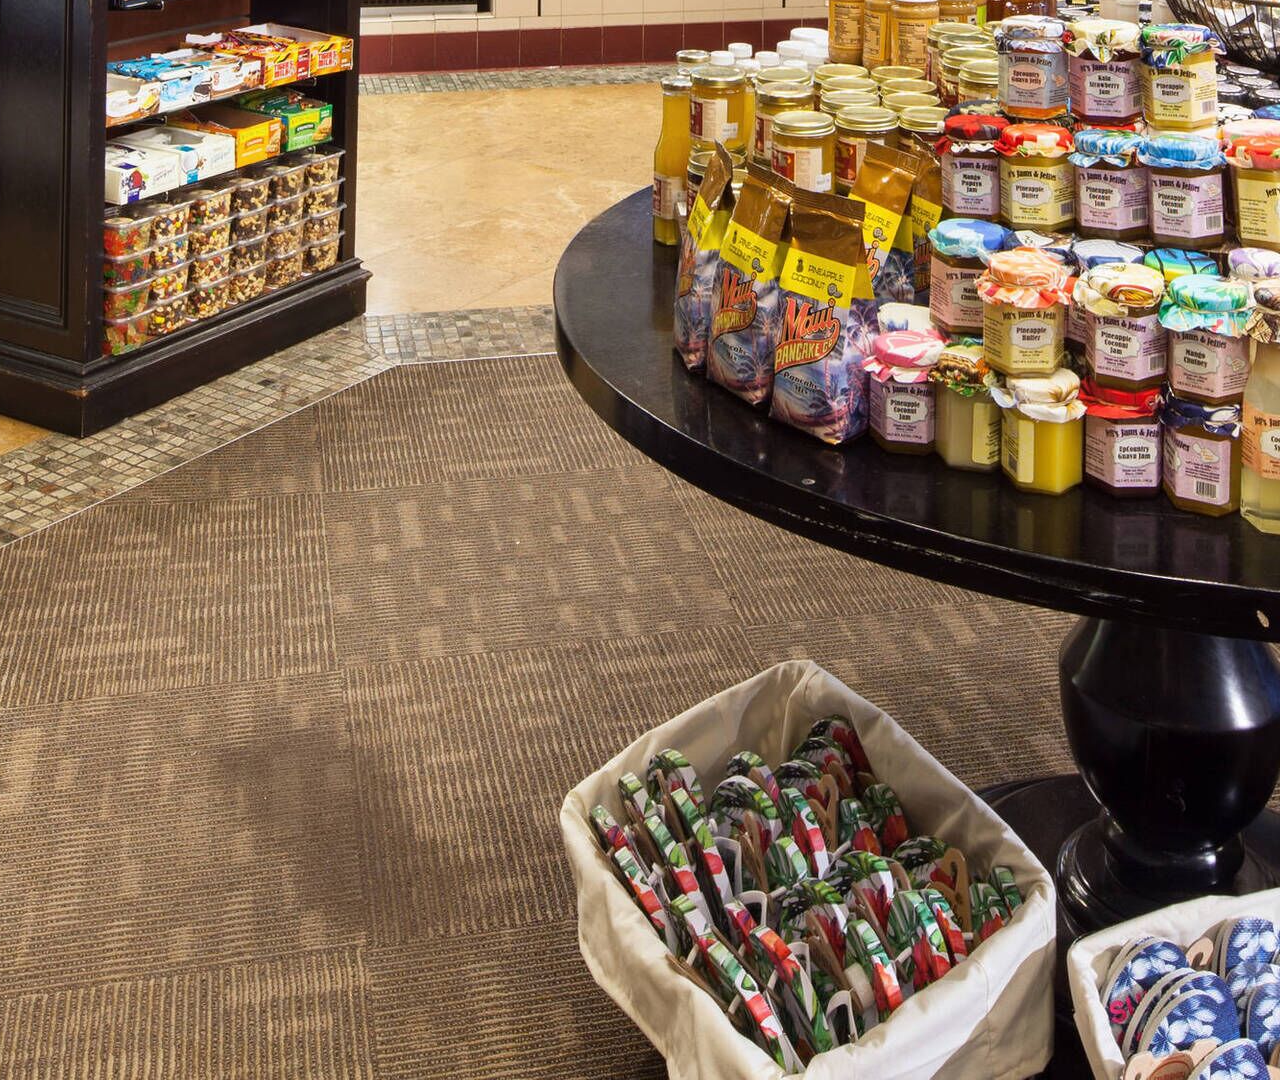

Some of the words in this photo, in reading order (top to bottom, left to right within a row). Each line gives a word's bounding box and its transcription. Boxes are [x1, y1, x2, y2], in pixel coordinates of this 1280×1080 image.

[808, 264, 845, 283] PINEAPPLE
[791, 272, 826, 290] COCONUT
[1016, 326, 1047, 336] Pineapple
[1100, 330, 1133, 342] Pineapple
[1021, 333, 1041, 342] Butter
[1104, 339, 1129, 350] Coconut
[775, 346, 820, 367] PANCAKE
[1109, 347, 1123, 356] Jam
[1185, 347, 1207, 358] Mango
[1183, 356, 1208, 368] Chutney
[890, 399, 920, 409] Pineapple
[893, 406, 917, 415] Coconut
[898, 413, 912, 421] Jam
